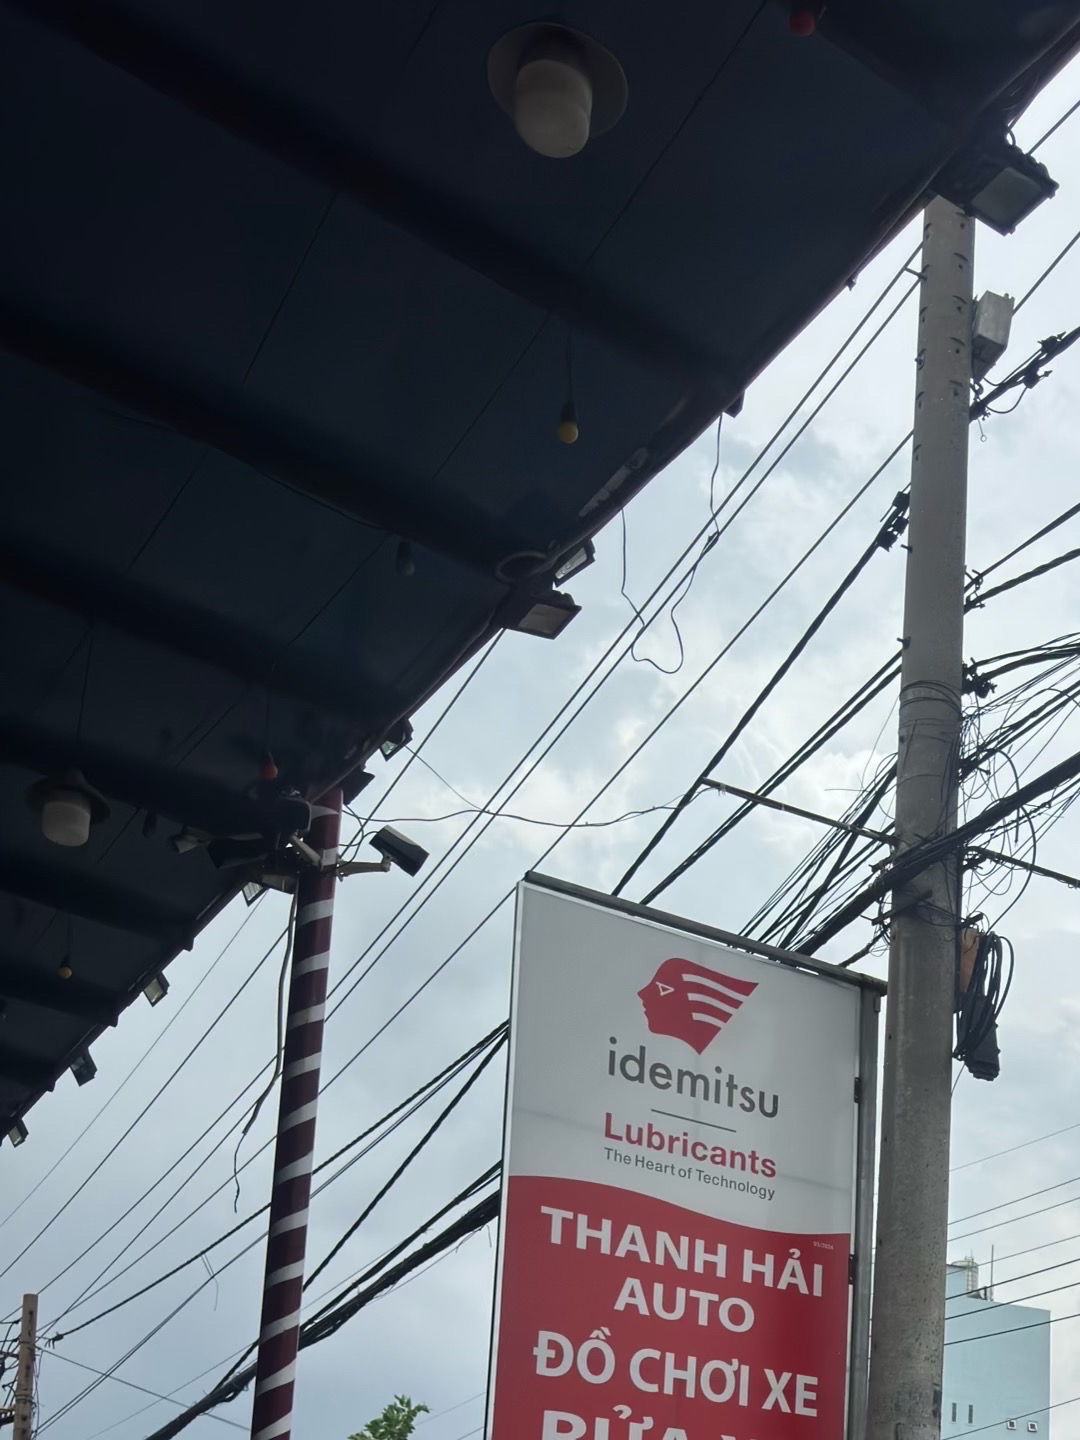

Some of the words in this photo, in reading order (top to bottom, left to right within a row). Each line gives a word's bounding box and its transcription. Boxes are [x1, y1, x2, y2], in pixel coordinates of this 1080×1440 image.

[608, 1036, 779, 1118] idemitsu
[604, 1112, 777, 1178] Lubricants
[604, 1147, 631, 1165] The
[635, 1154, 676, 1177] Heart
[678, 1165, 692, 1180] of
[697, 1169, 776, 1201] Technology
[540, 1205, 727, 1278] THANH
[742, 1248, 823, 1298] HẢI
[613, 1277, 755, 1333] AUTO
[533, 1327, 616, 1385] ĐỒ
[629, 1348, 749, 1407] CHƠI
[761, 1369, 818, 1417] XE
